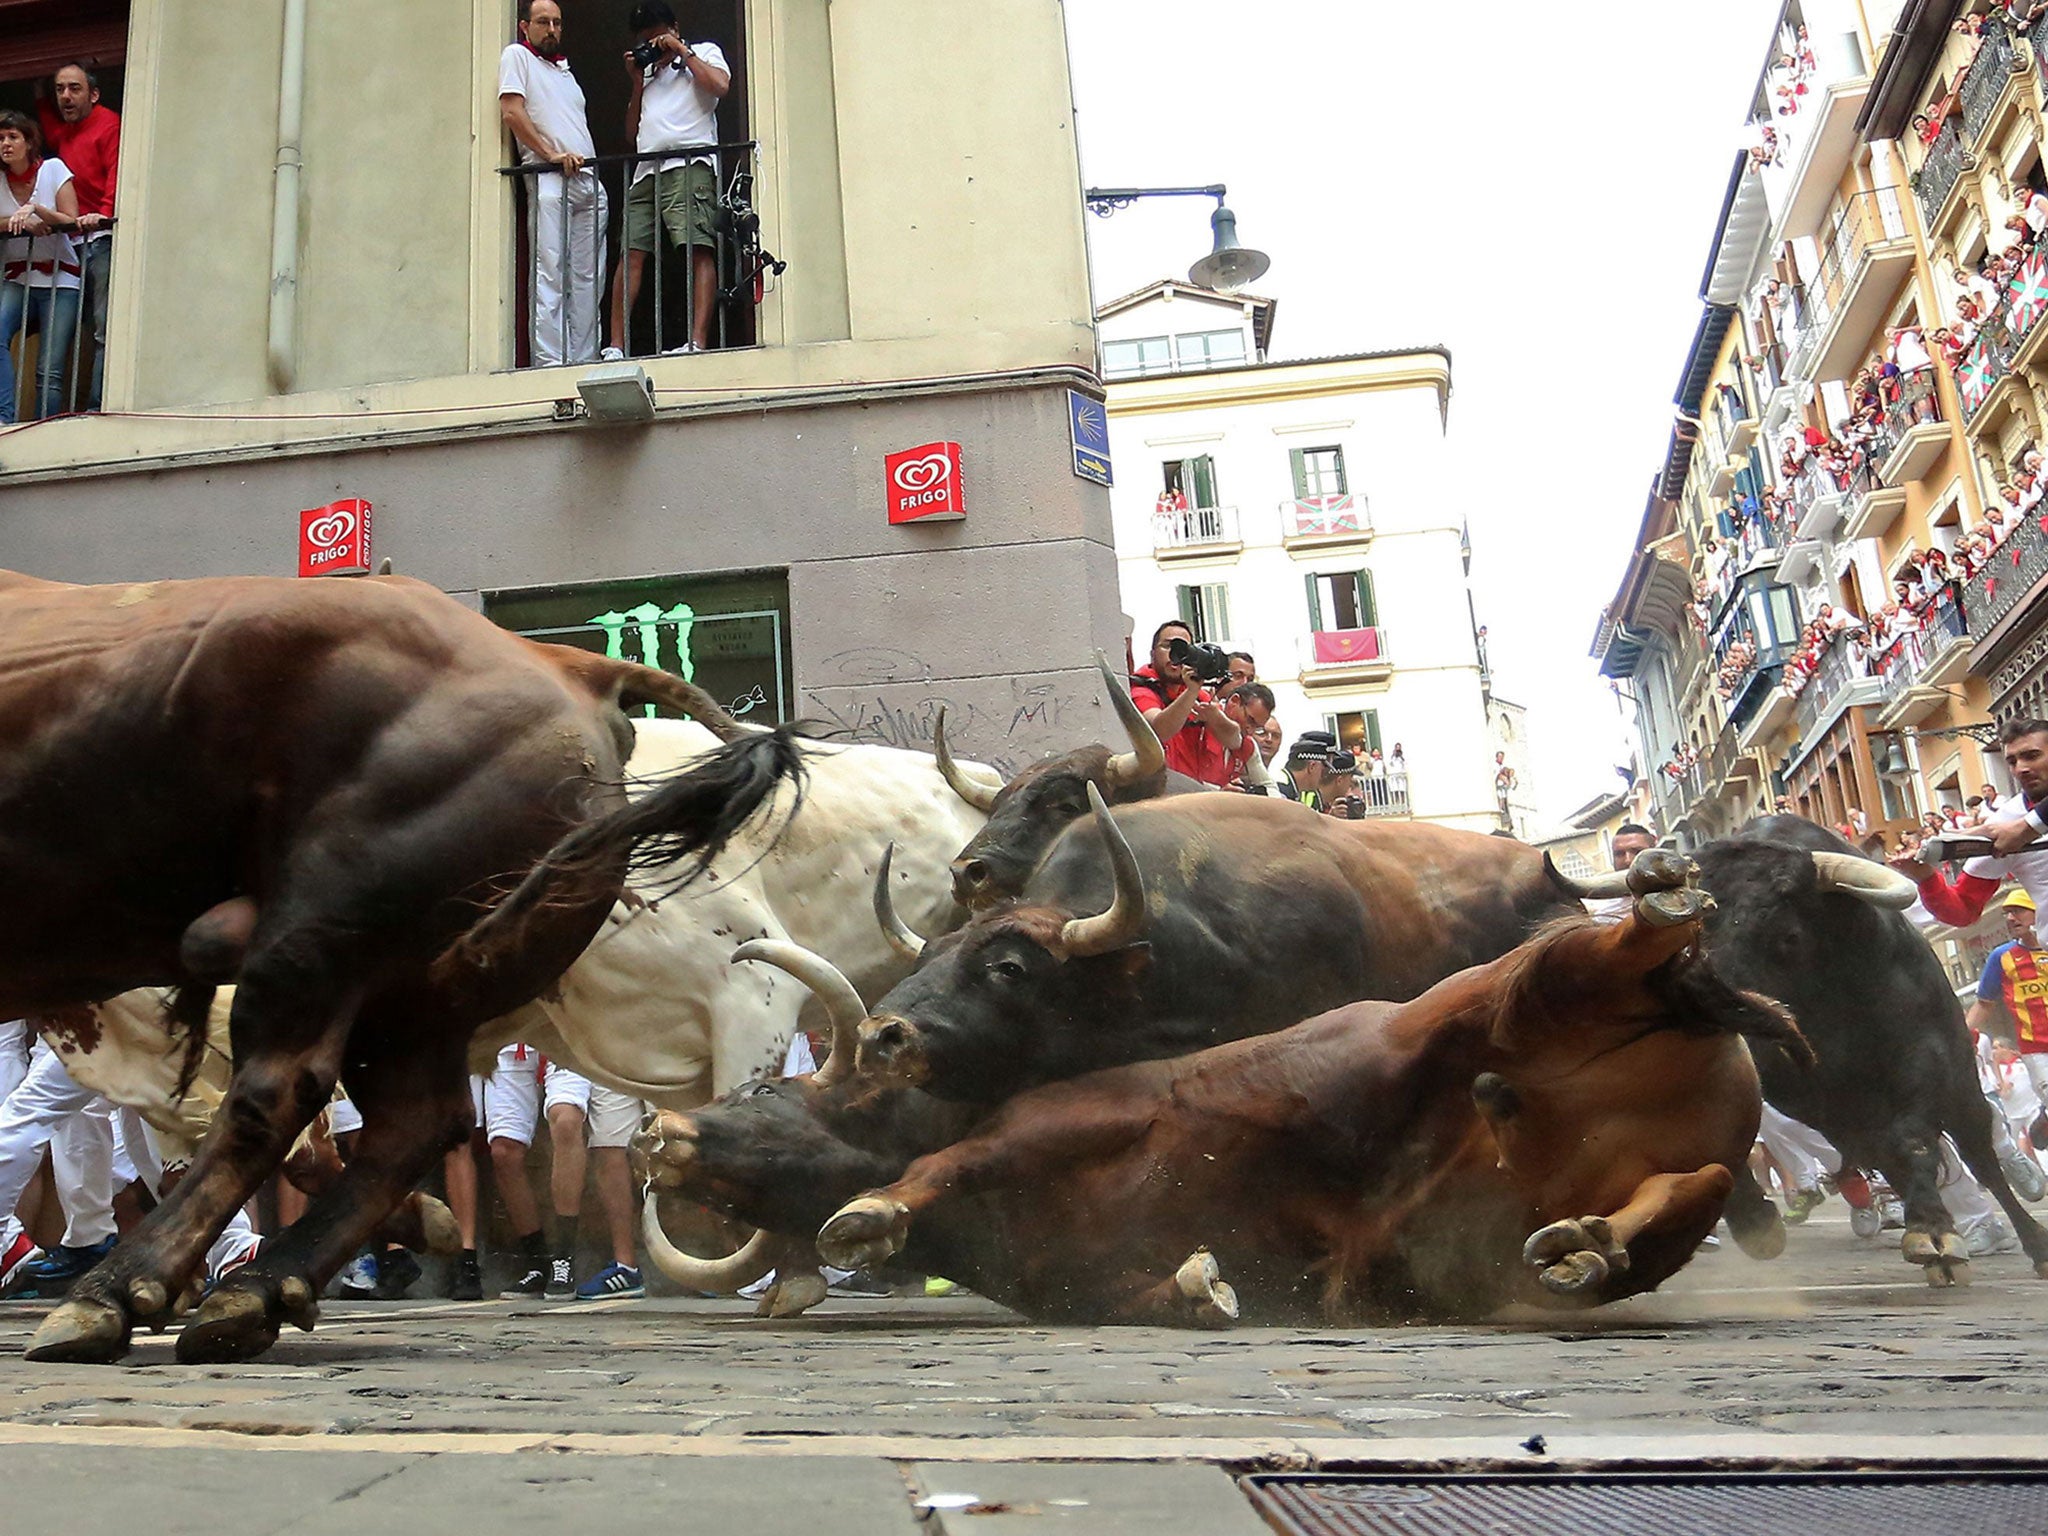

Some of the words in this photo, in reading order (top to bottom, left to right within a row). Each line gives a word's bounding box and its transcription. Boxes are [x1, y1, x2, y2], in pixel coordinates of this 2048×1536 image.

[900, 489, 947, 511] FRIGO
[363, 509, 371, 548] FRIGO
[310, 545, 348, 566] FRIGO
